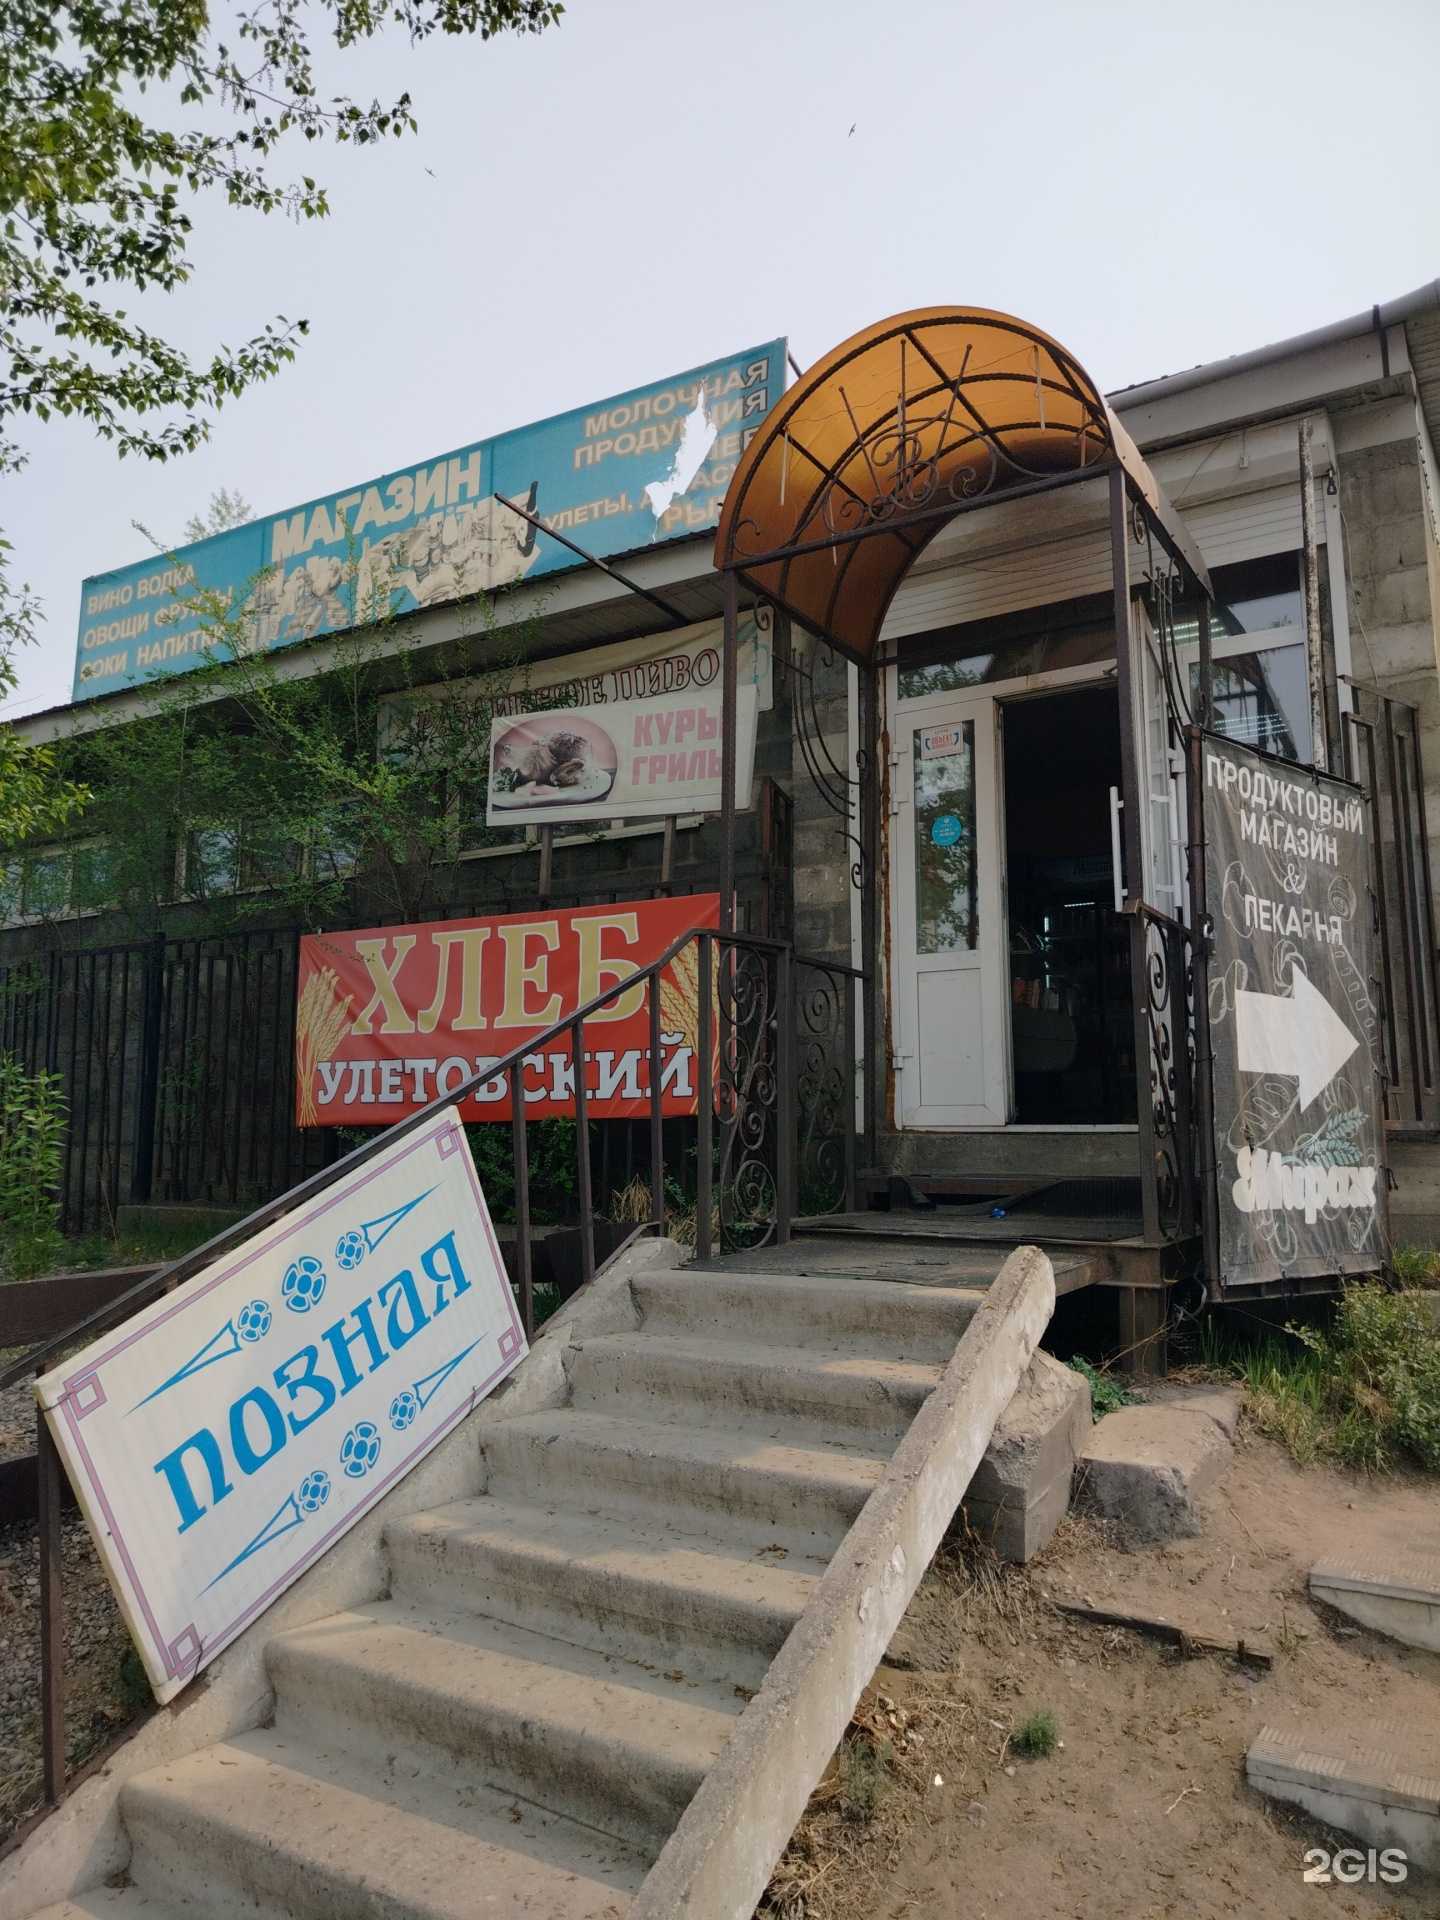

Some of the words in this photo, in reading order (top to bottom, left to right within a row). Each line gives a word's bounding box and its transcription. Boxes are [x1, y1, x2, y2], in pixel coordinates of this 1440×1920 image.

[584, 357, 770, 438] МОЛОЧНАЯ
[573, 387, 768, 468] ПРОДУИЯ
[271, 451, 481, 562] МАГАЗИН
[87, 585, 133, 615] ВИНО
[137, 564, 195, 599] ВОДКА
[83, 611, 149, 649] ОВОЩИ
[80, 650, 128, 682] СОКИ
[612, 648, 720, 701] ПИВО
[632, 704, 722, 748] КУРЫ
[631, 748, 722, 786] ГРИЛЬ
[1206, 754, 1363, 835] ПРОДУКТОВЫЙ
[1240, 808, 1338, 866] МАГАЗИН
[1283, 863, 1302, 894] &
[1244, 894, 1343, 946] ПЕКАРНЯ
[351, 912, 648, 1035] ХЛЕБ
[317, 1031, 695, 1104] УЛЕТОВСКИЙ
